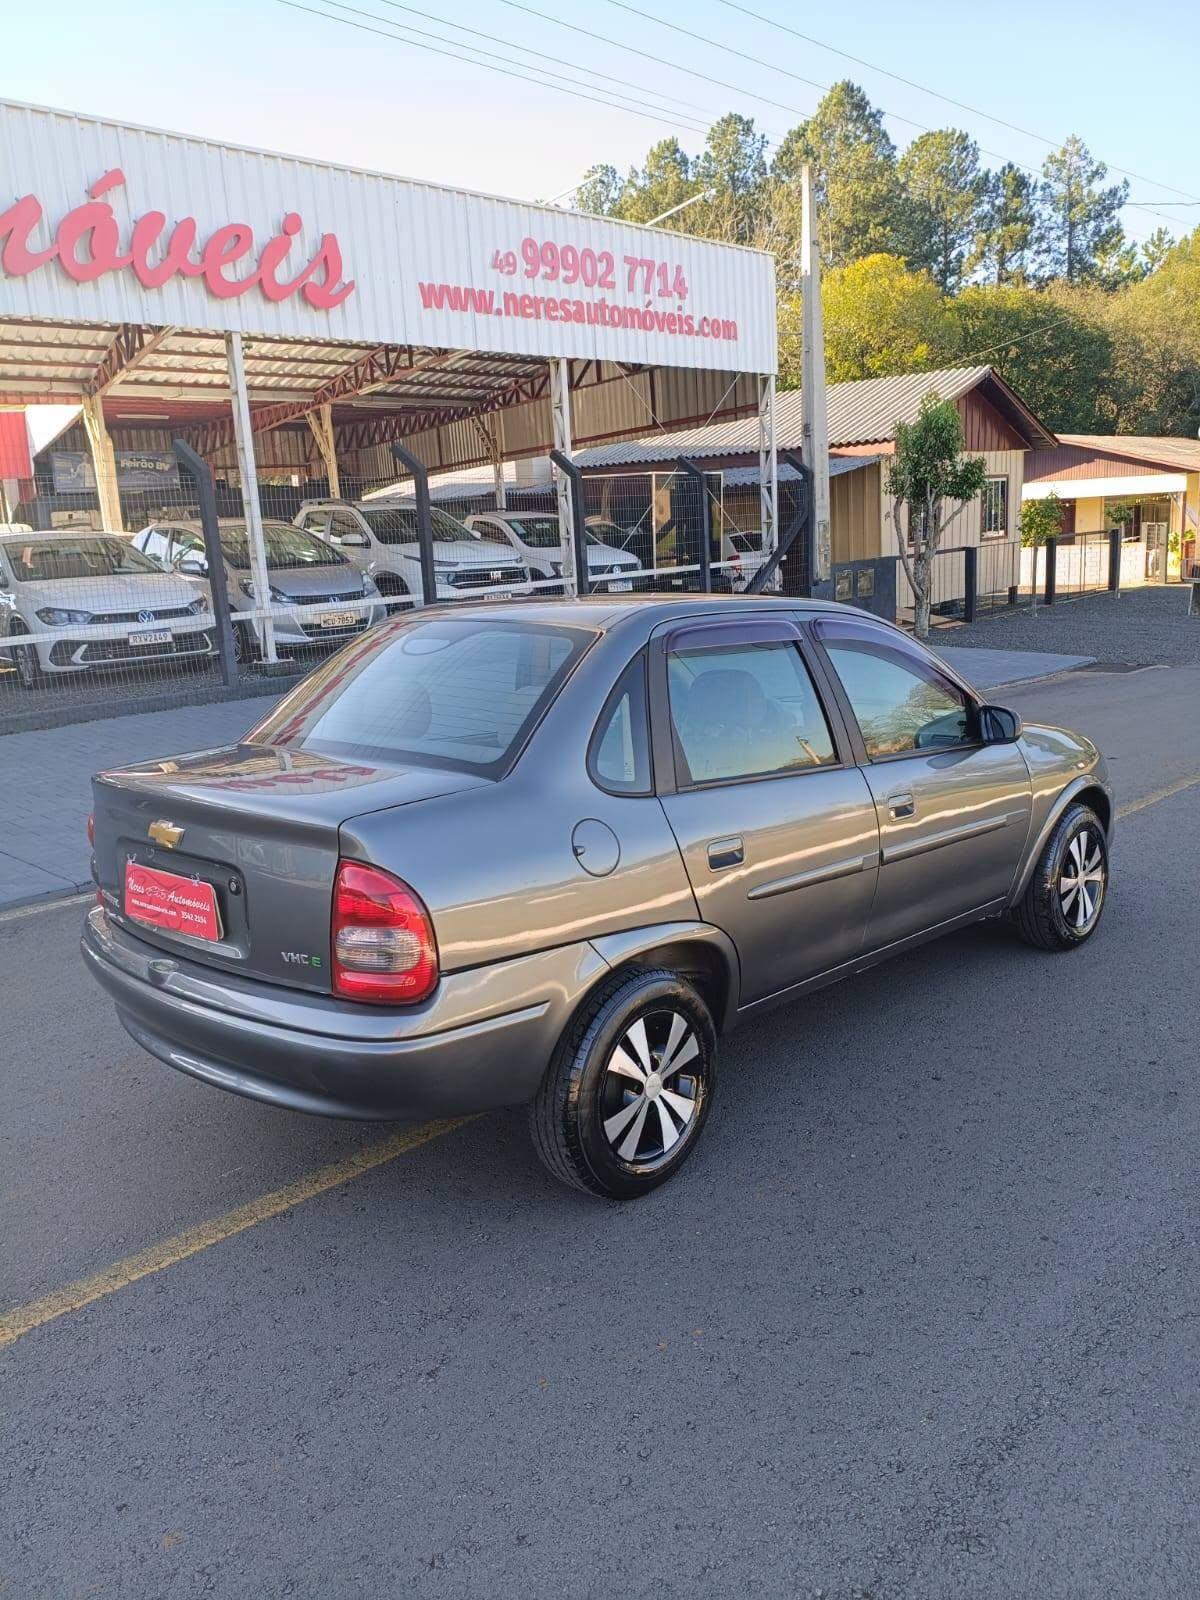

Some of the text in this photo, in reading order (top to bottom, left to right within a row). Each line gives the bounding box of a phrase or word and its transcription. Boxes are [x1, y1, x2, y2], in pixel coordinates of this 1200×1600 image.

[492, 237, 689, 300] 49 99902 7714
[418, 282, 738, 341] www.neresautomóveis.com
